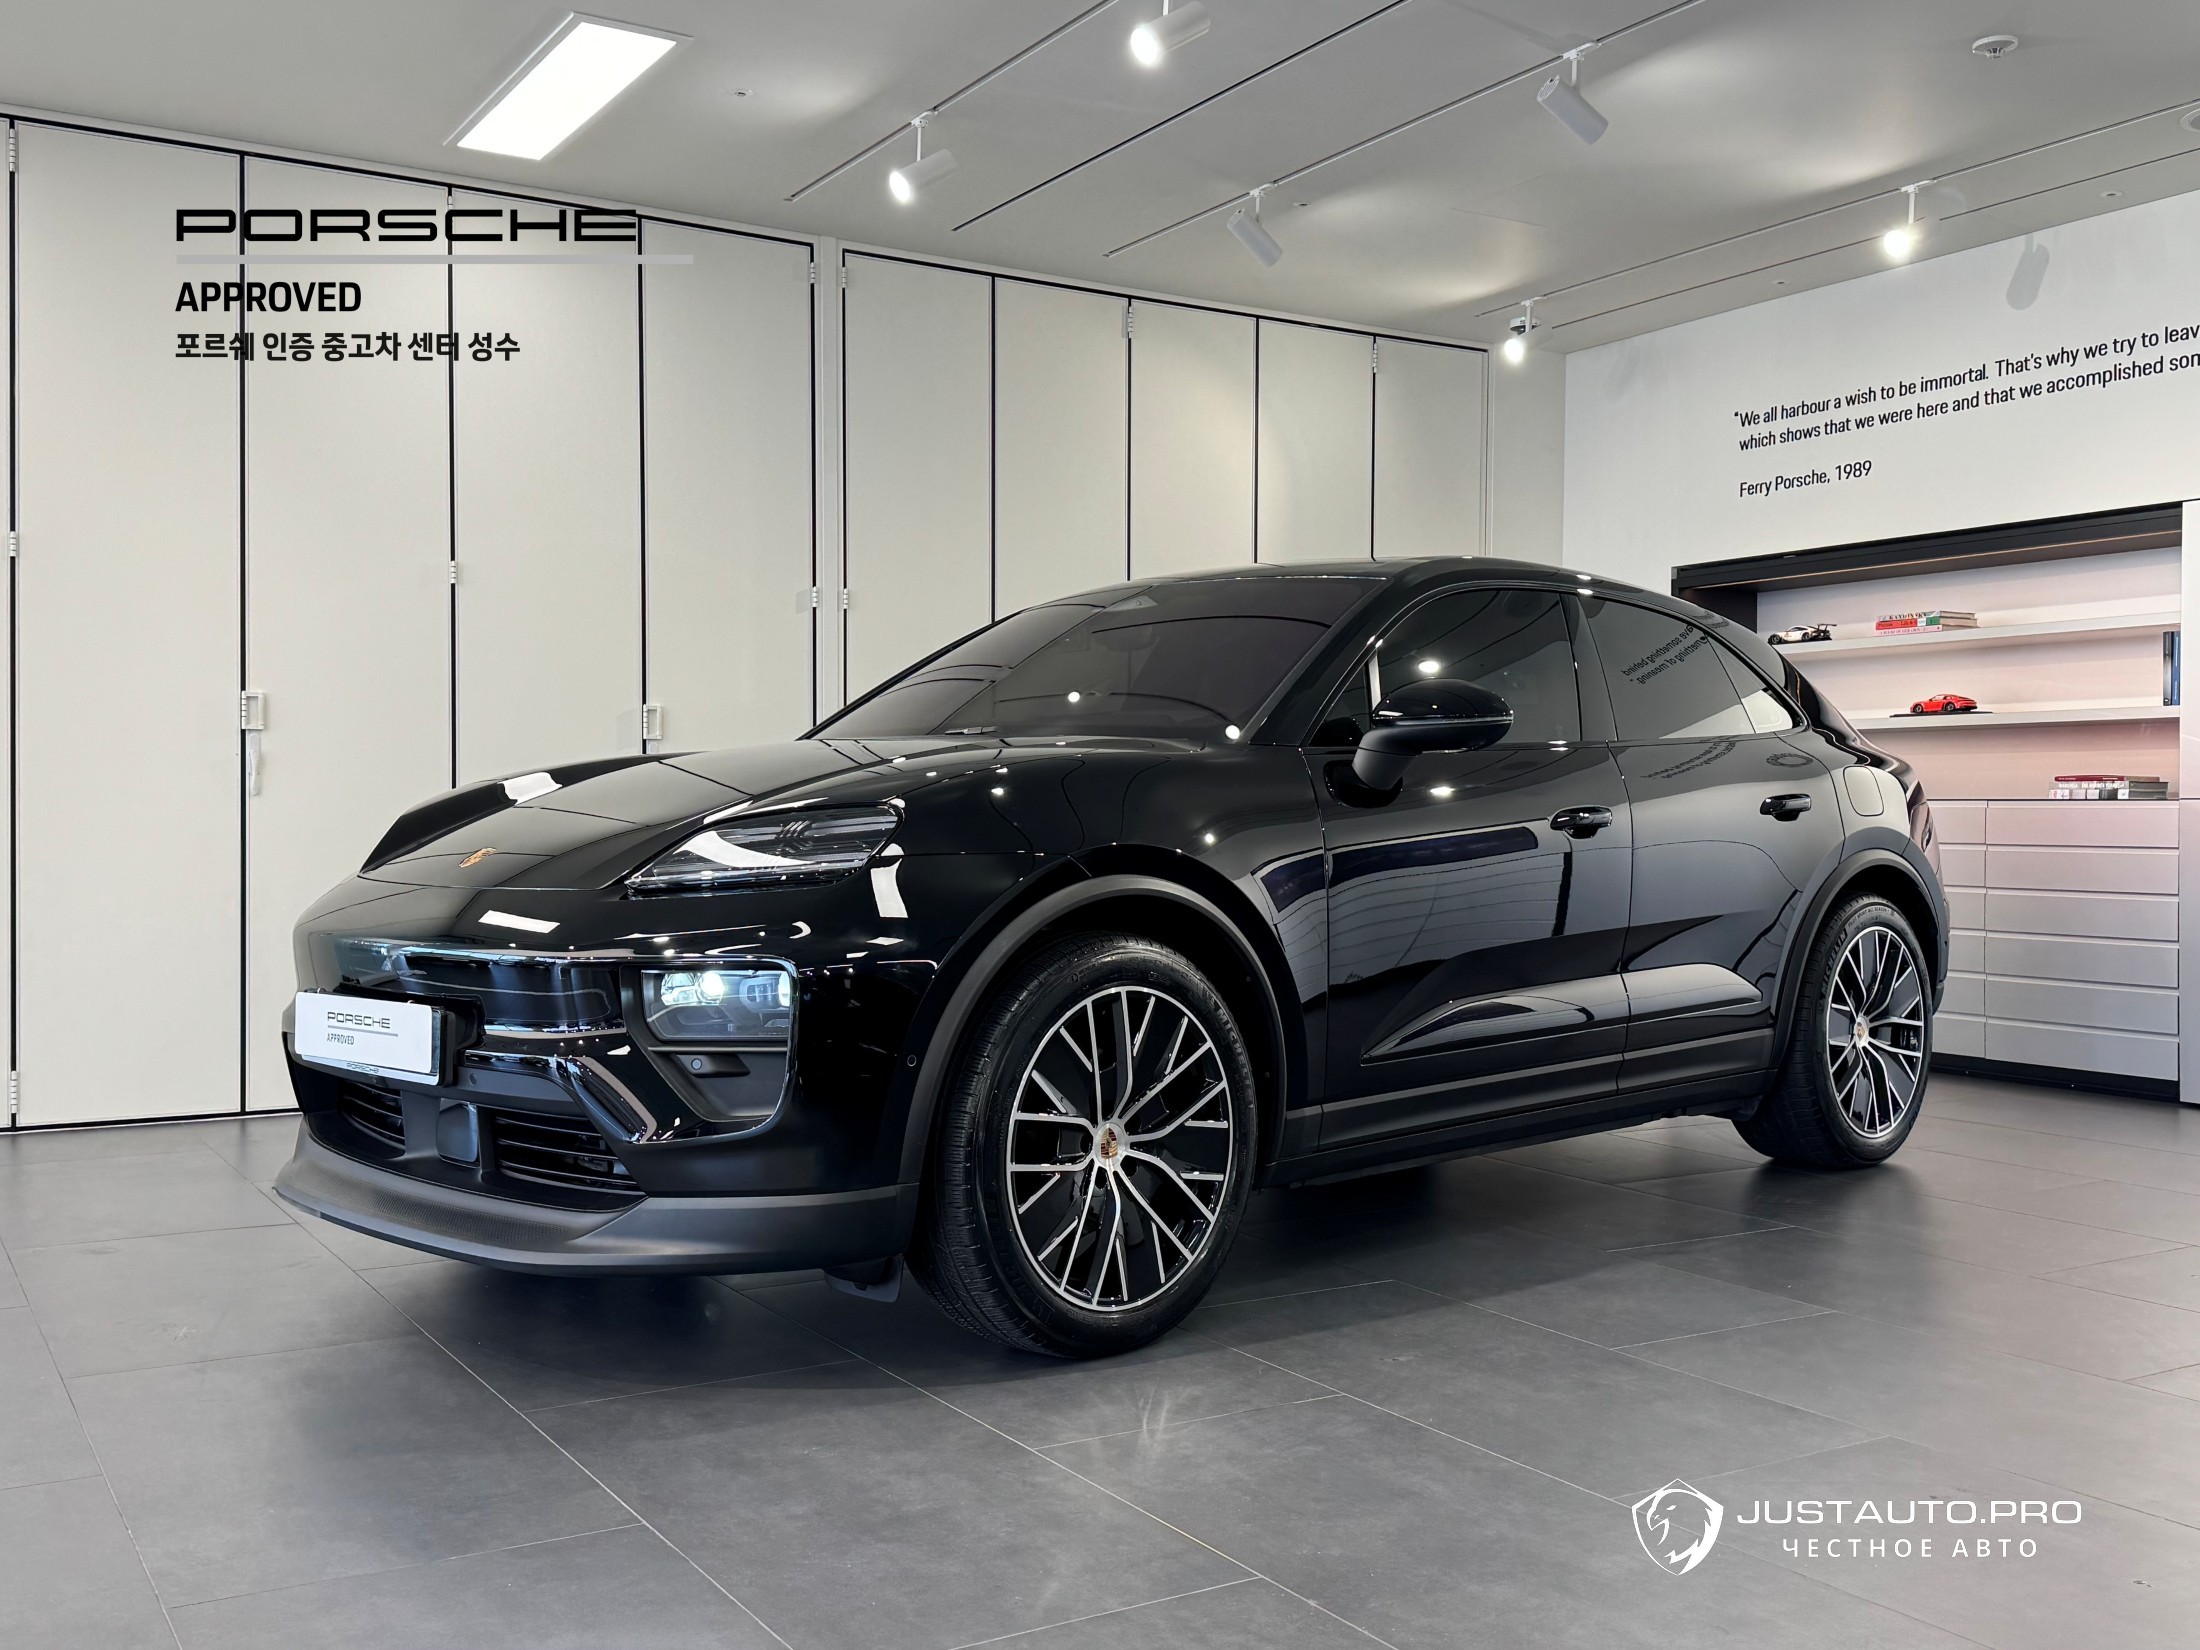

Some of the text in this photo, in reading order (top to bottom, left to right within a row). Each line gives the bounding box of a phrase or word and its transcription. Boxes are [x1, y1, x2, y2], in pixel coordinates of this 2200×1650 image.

[1763, 405, 1777, 423] all
[1781, 399, 1831, 420] harbour
[1833, 397, 1842, 409] a
[1845, 386, 1877, 407] wish
[1880, 386, 1895, 400] to
[1899, 381, 1917, 397] be
[1920, 363, 1989, 392] immortal.
[1995, 353, 2042, 377] That's
[2046, 346, 2080, 367] why
[2083, 342, 2108, 359] we
[2112, 337, 2137, 356] try
[2141, 332, 2159, 348] to
[1739, 431, 1776, 451] which
[1779, 425, 1821, 444] shows
[1824, 417, 1851, 435] that
[1855, 415, 1875, 430] we
[1878, 408, 1913, 425] were
[1917, 402, 1949, 419] here
[1952, 391, 1980, 412] and
[1984, 386, 2016, 406] that
[2019, 382, 2043, 399] we
[2046, 355, 2164, 393] accomplished
[1739, 460, 1872, 498] Ferry Porsche, 1989
[1820, 930, 1846, 993] MICHELIN
[326, 1033, 355, 1046] APPROVED
[327, 1011, 391, 1030] PORSCHE
[346, 1062, 380, 1074] PORSCHE
